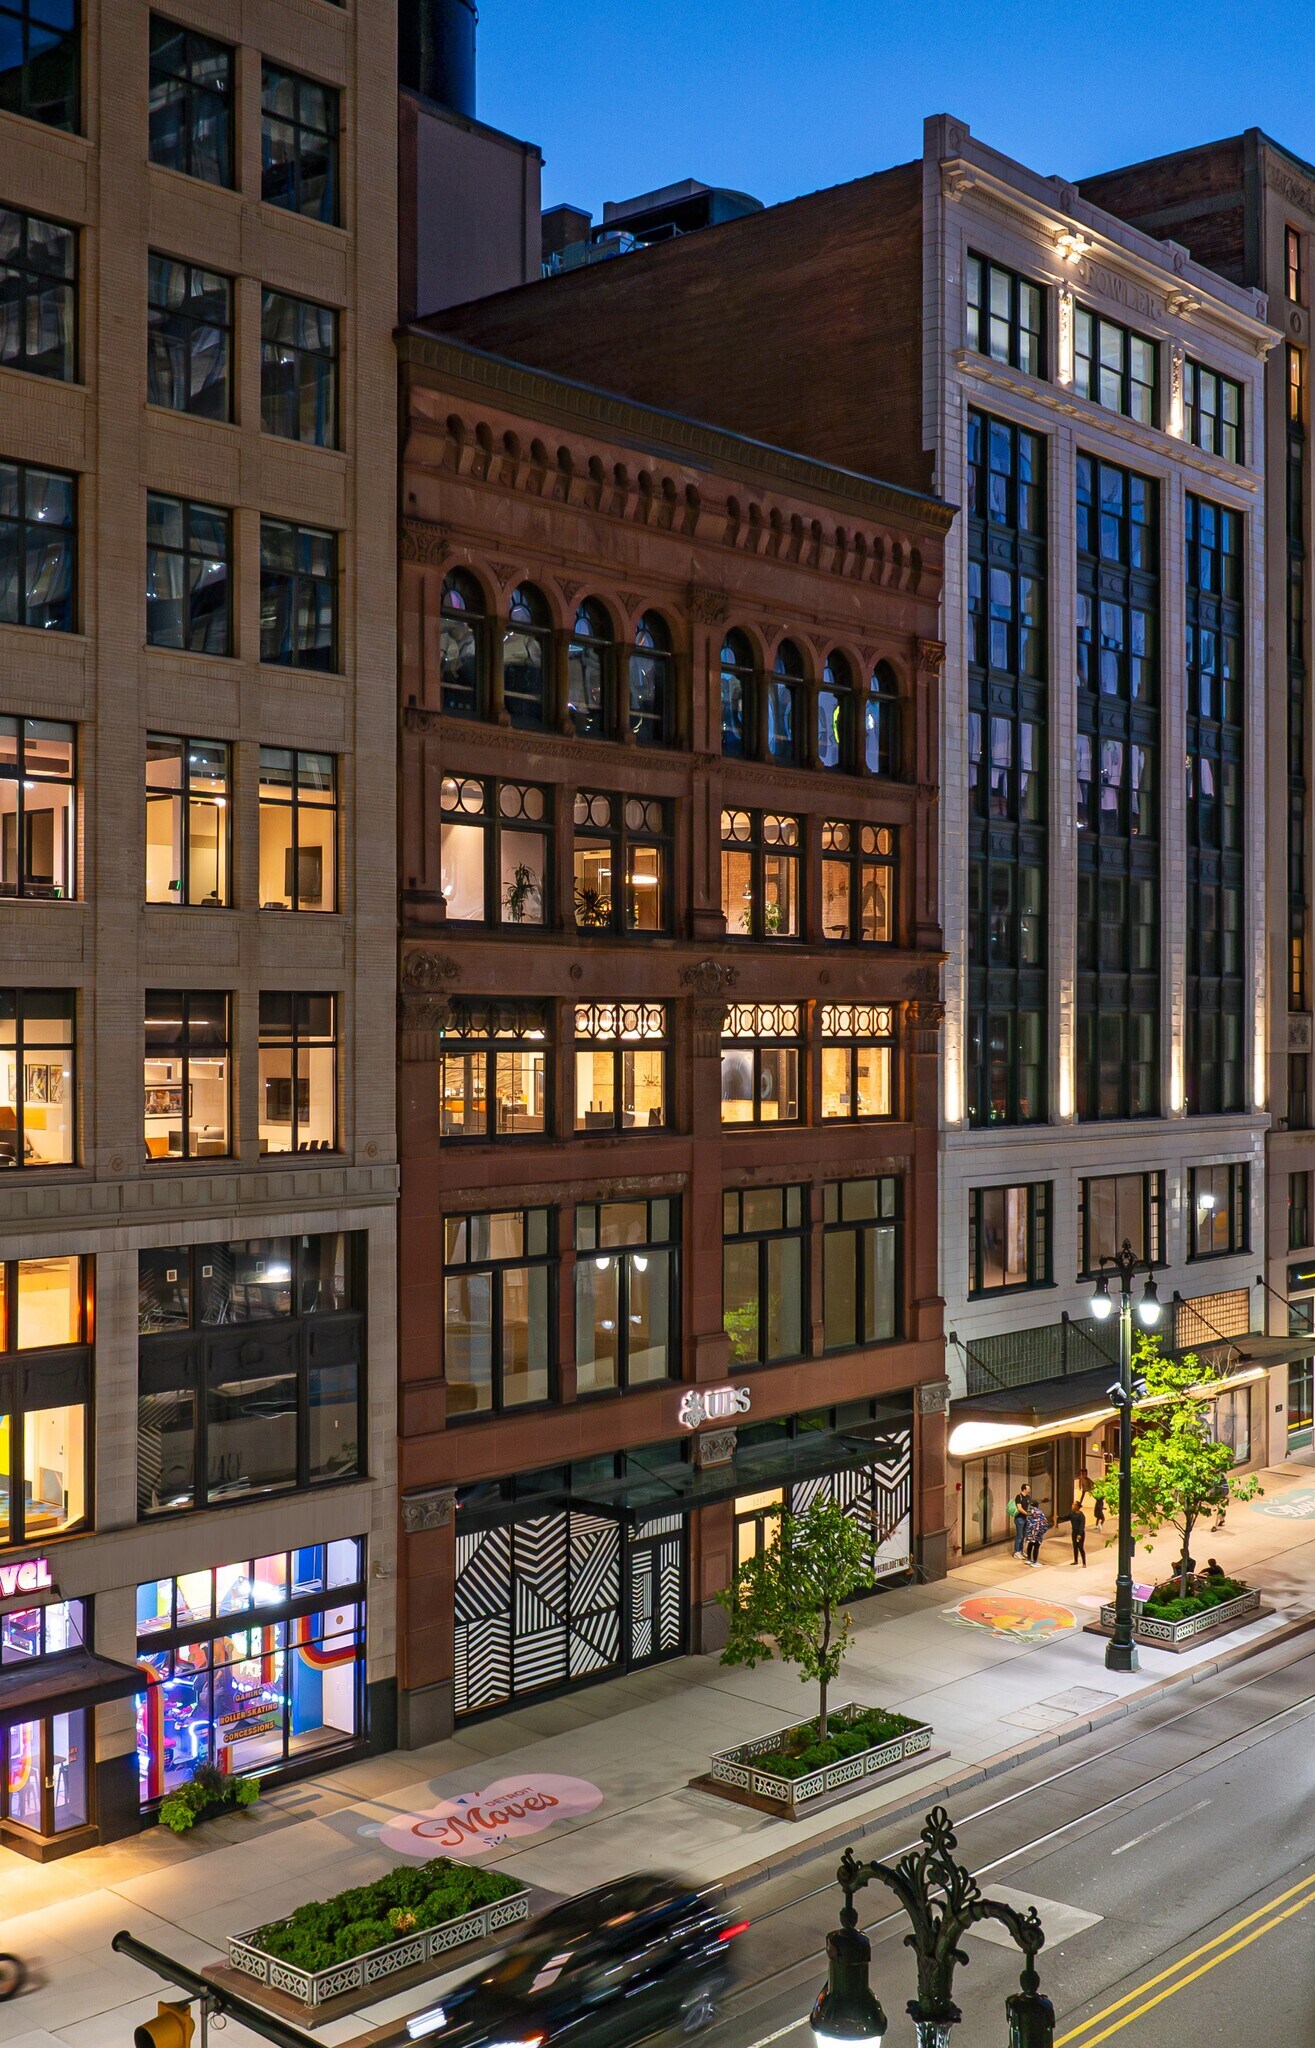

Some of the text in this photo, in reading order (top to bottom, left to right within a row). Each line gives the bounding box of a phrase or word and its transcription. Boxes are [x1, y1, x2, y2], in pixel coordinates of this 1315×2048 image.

[1088, 266, 1158, 320] FOWLER
[706, 1387, 751, 1418] UBS
[234, 1687, 264, 1703] GAMING
[219, 1702, 279, 1726] ROLLER SKATING
[223, 1720, 275, 1743] CONCESSIONS
[484, 1786, 534, 1807] DETROIT
[411, 1791, 560, 1847] Moves
